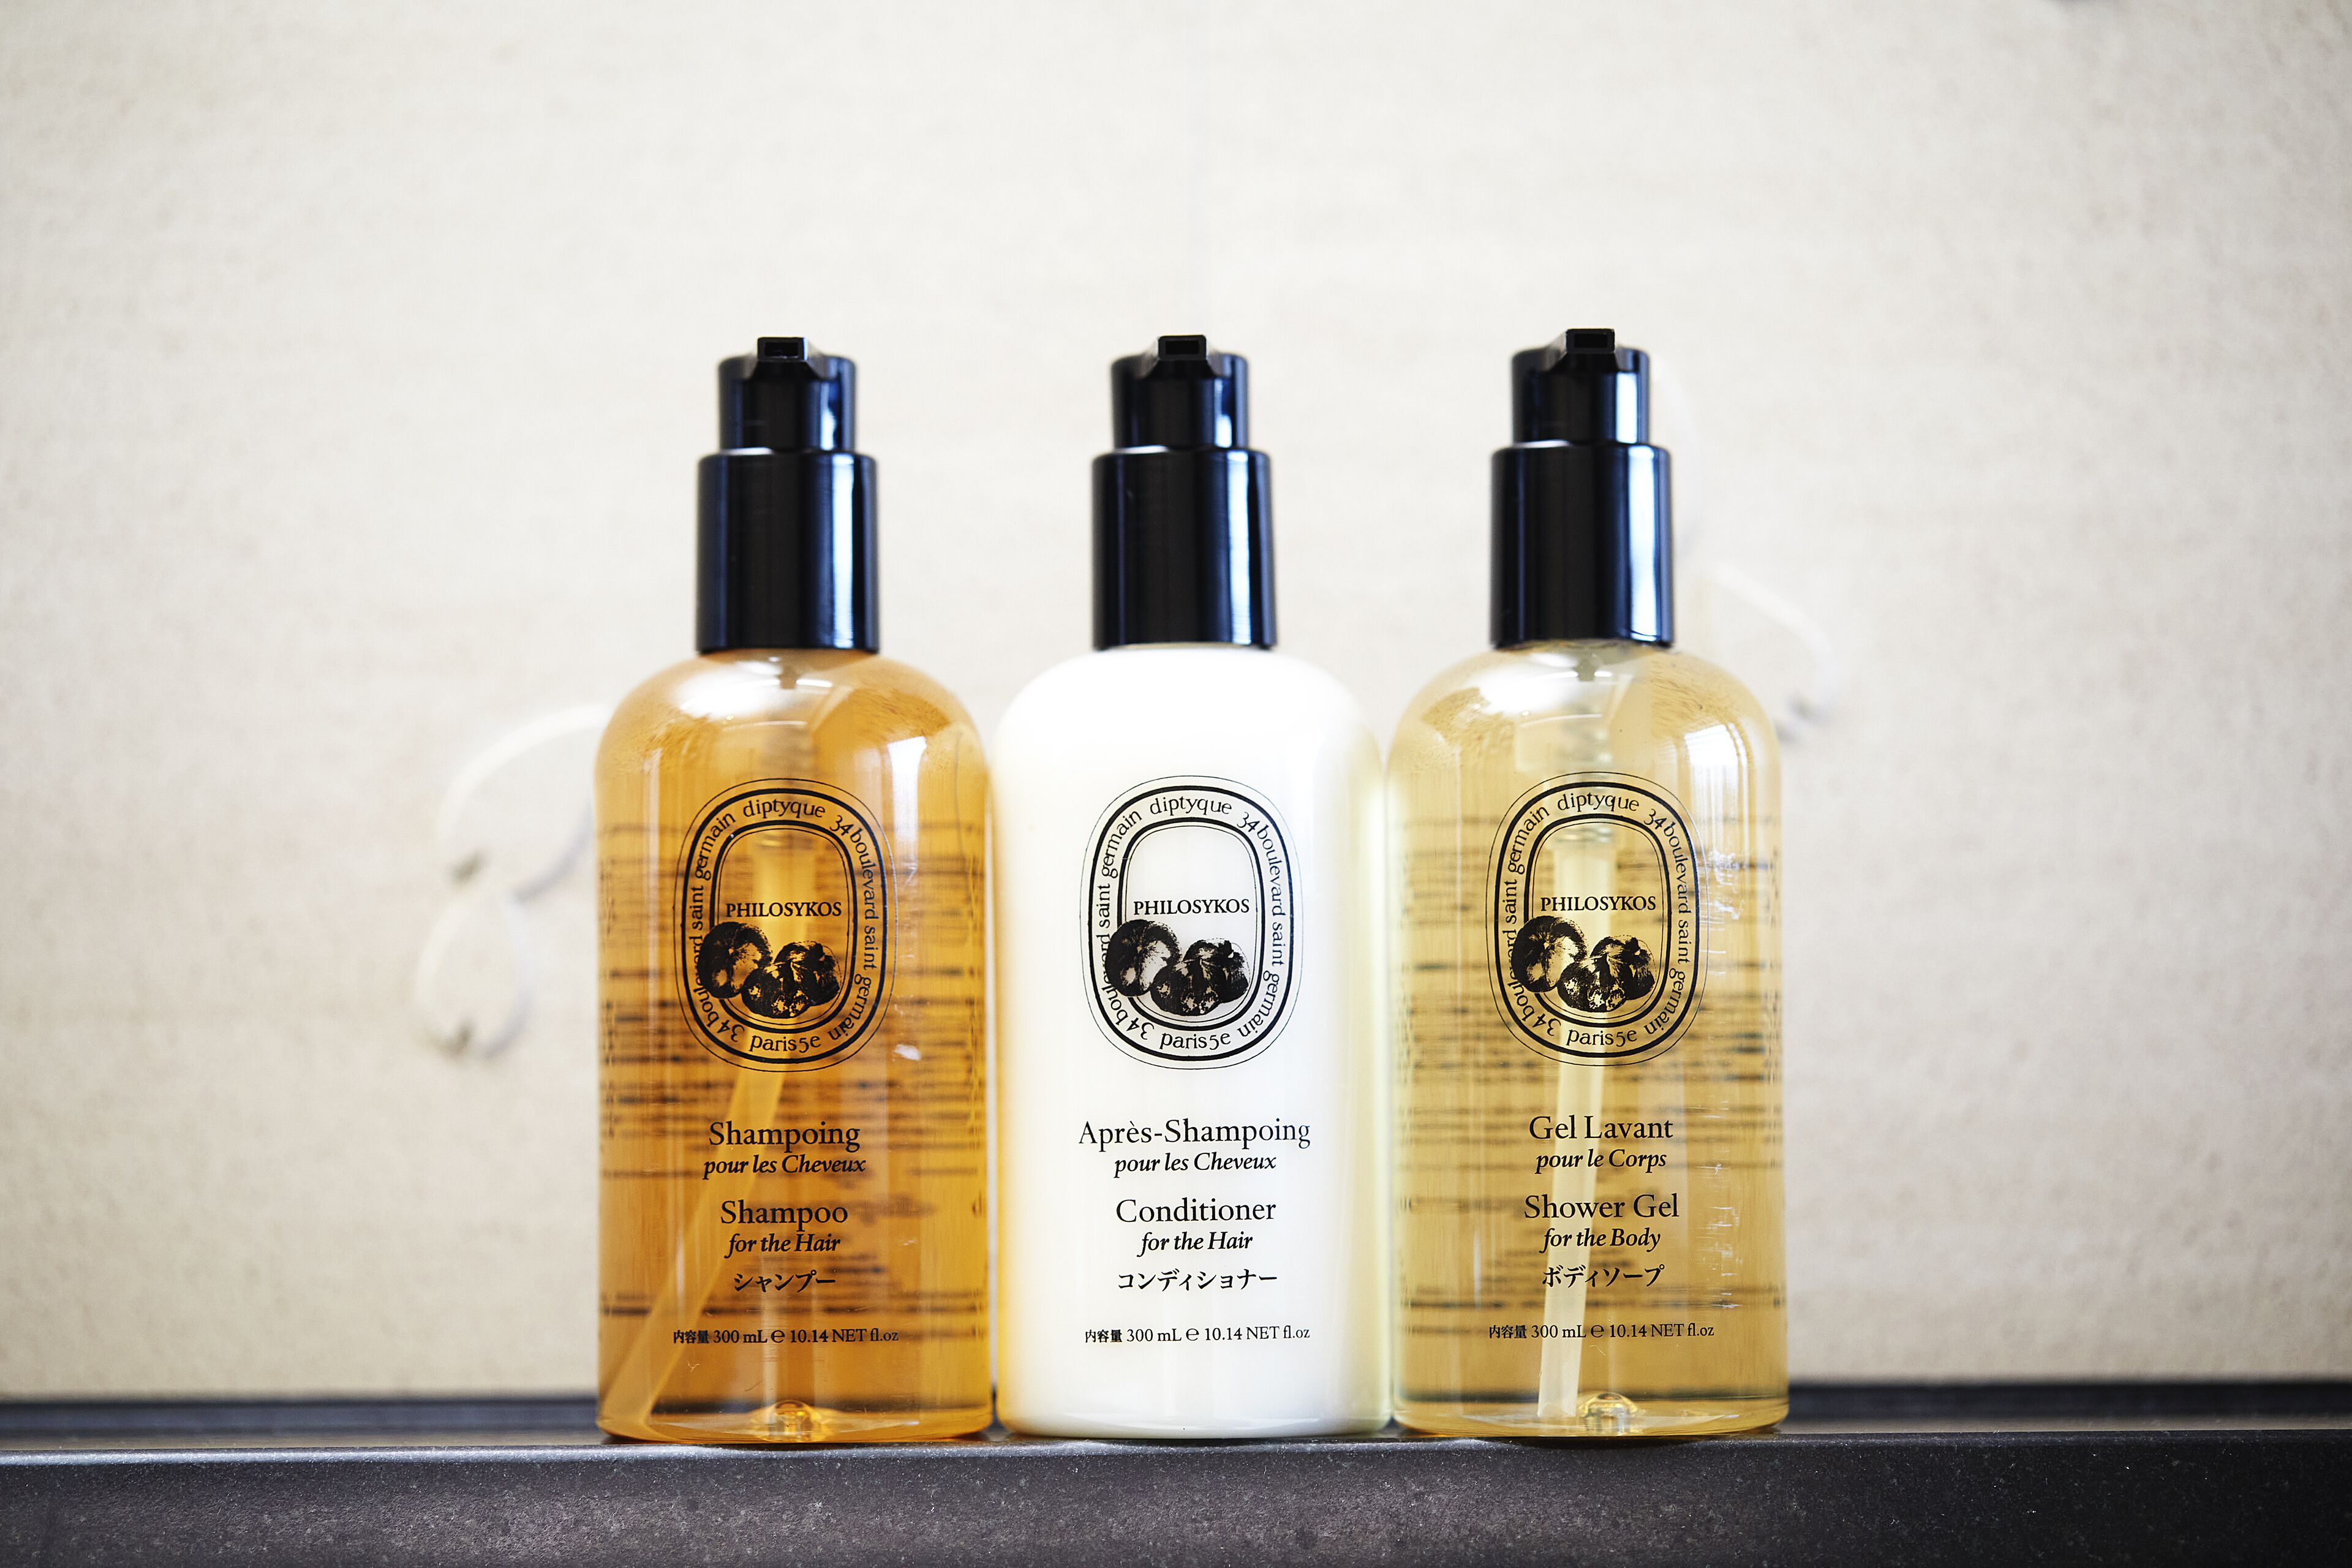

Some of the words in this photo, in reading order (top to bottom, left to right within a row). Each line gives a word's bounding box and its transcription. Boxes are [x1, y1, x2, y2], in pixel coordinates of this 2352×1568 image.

[743, 799, 826, 819] diptyque
[1150, 796, 1232, 816] diptyque
[1558, 793, 1639, 813] diptyque
[695, 813, 736, 881] germain
[1101, 811, 1142, 879] germain
[1508, 806, 1550, 875] germain
[690, 885, 704, 930] saint
[726, 902, 842, 918] PHILOSYKOS
[1096, 884, 1110, 929] saint
[1134, 899, 1250, 915] PHILOSYKOS
[1503, 879, 1517, 924] saint
[1540, 895, 1656, 911] PHILOSYKOS
[864, 926, 877, 971] saint
[1272, 922, 1284, 968] saint
[1678, 919, 1691, 965] saint
[828, 973, 871, 1041] germain
[1238, 970, 1280, 1038] germain
[1644, 967, 1686, 1035] germain
[709, 1121, 860, 1153] Shampoing
[1079, 1118, 1310, 1152] Après-Shampoing
[1529, 1115, 1577, 1139] Gel
[1584, 1115, 1673, 1139] Lavant
[703, 1160, 748, 1180] pour
[753, 1155, 777, 1173] les
[782, 1154, 866, 1173] Cheveux
[1114, 1159, 1160, 1178] pour
[1165, 1153, 1189, 1171] les
[1194, 1152, 1276, 1170] Cheveux
[1535, 1154, 1583, 1174] pour
[1588, 1148, 1604, 1167] le
[1609, 1149, 1667, 1173] Corps
[720, 1200, 848, 1232] Shampoo
[1116, 1197, 1276, 1223] Conditioner
[1524, 1194, 1625, 1219] Shower
[1634, 1193, 1679, 1218] Gel
[724, 1234, 756, 1259] for
[761, 1234, 791, 1252] the
[795, 1234, 840, 1252] Hair
[1137, 1232, 1169, 1257] for
[1174, 1232, 1204, 1250] the
[1207, 1231, 1253, 1250] Hair
[1539, 1228, 1572, 1253] for
[1576, 1228, 1606, 1246] the
[1610, 1227, 1660, 1252] Body
[734, 1269, 835, 1292] シャンプー
[1118, 1268, 1277, 1291] コンディショナー
[1542, 1264, 1665, 1287] ボディソープ
[674, 1330, 709, 1344] 内容量
[714, 1330, 739, 1343] 300
[743, 1330, 767, 1343] mL
[790, 1329, 828, 1343] 10.14
[832, 1329, 867, 1342] NET
[870, 1328, 899, 1341] fl.oz
[1085, 1329, 1122, 1343] 内容量
[1127, 1329, 1153, 1341] 300
[1158, 1329, 1182, 1341] mL
[1205, 1327, 1242, 1341] 10.14
[1246, 1326, 1280, 1340] NET
[1283, 1325, 1310, 1339] fl.oz
[1489, 1325, 1526, 1339] 内容量
[1531, 1325, 1558, 1338] 300
[1562, 1324, 1586, 1338] mL
[1610, 1324, 1647, 1337] 10.14
[1651, 1323, 1684, 1336] NET
[1687, 1322, 1714, 1336] fl.oz
